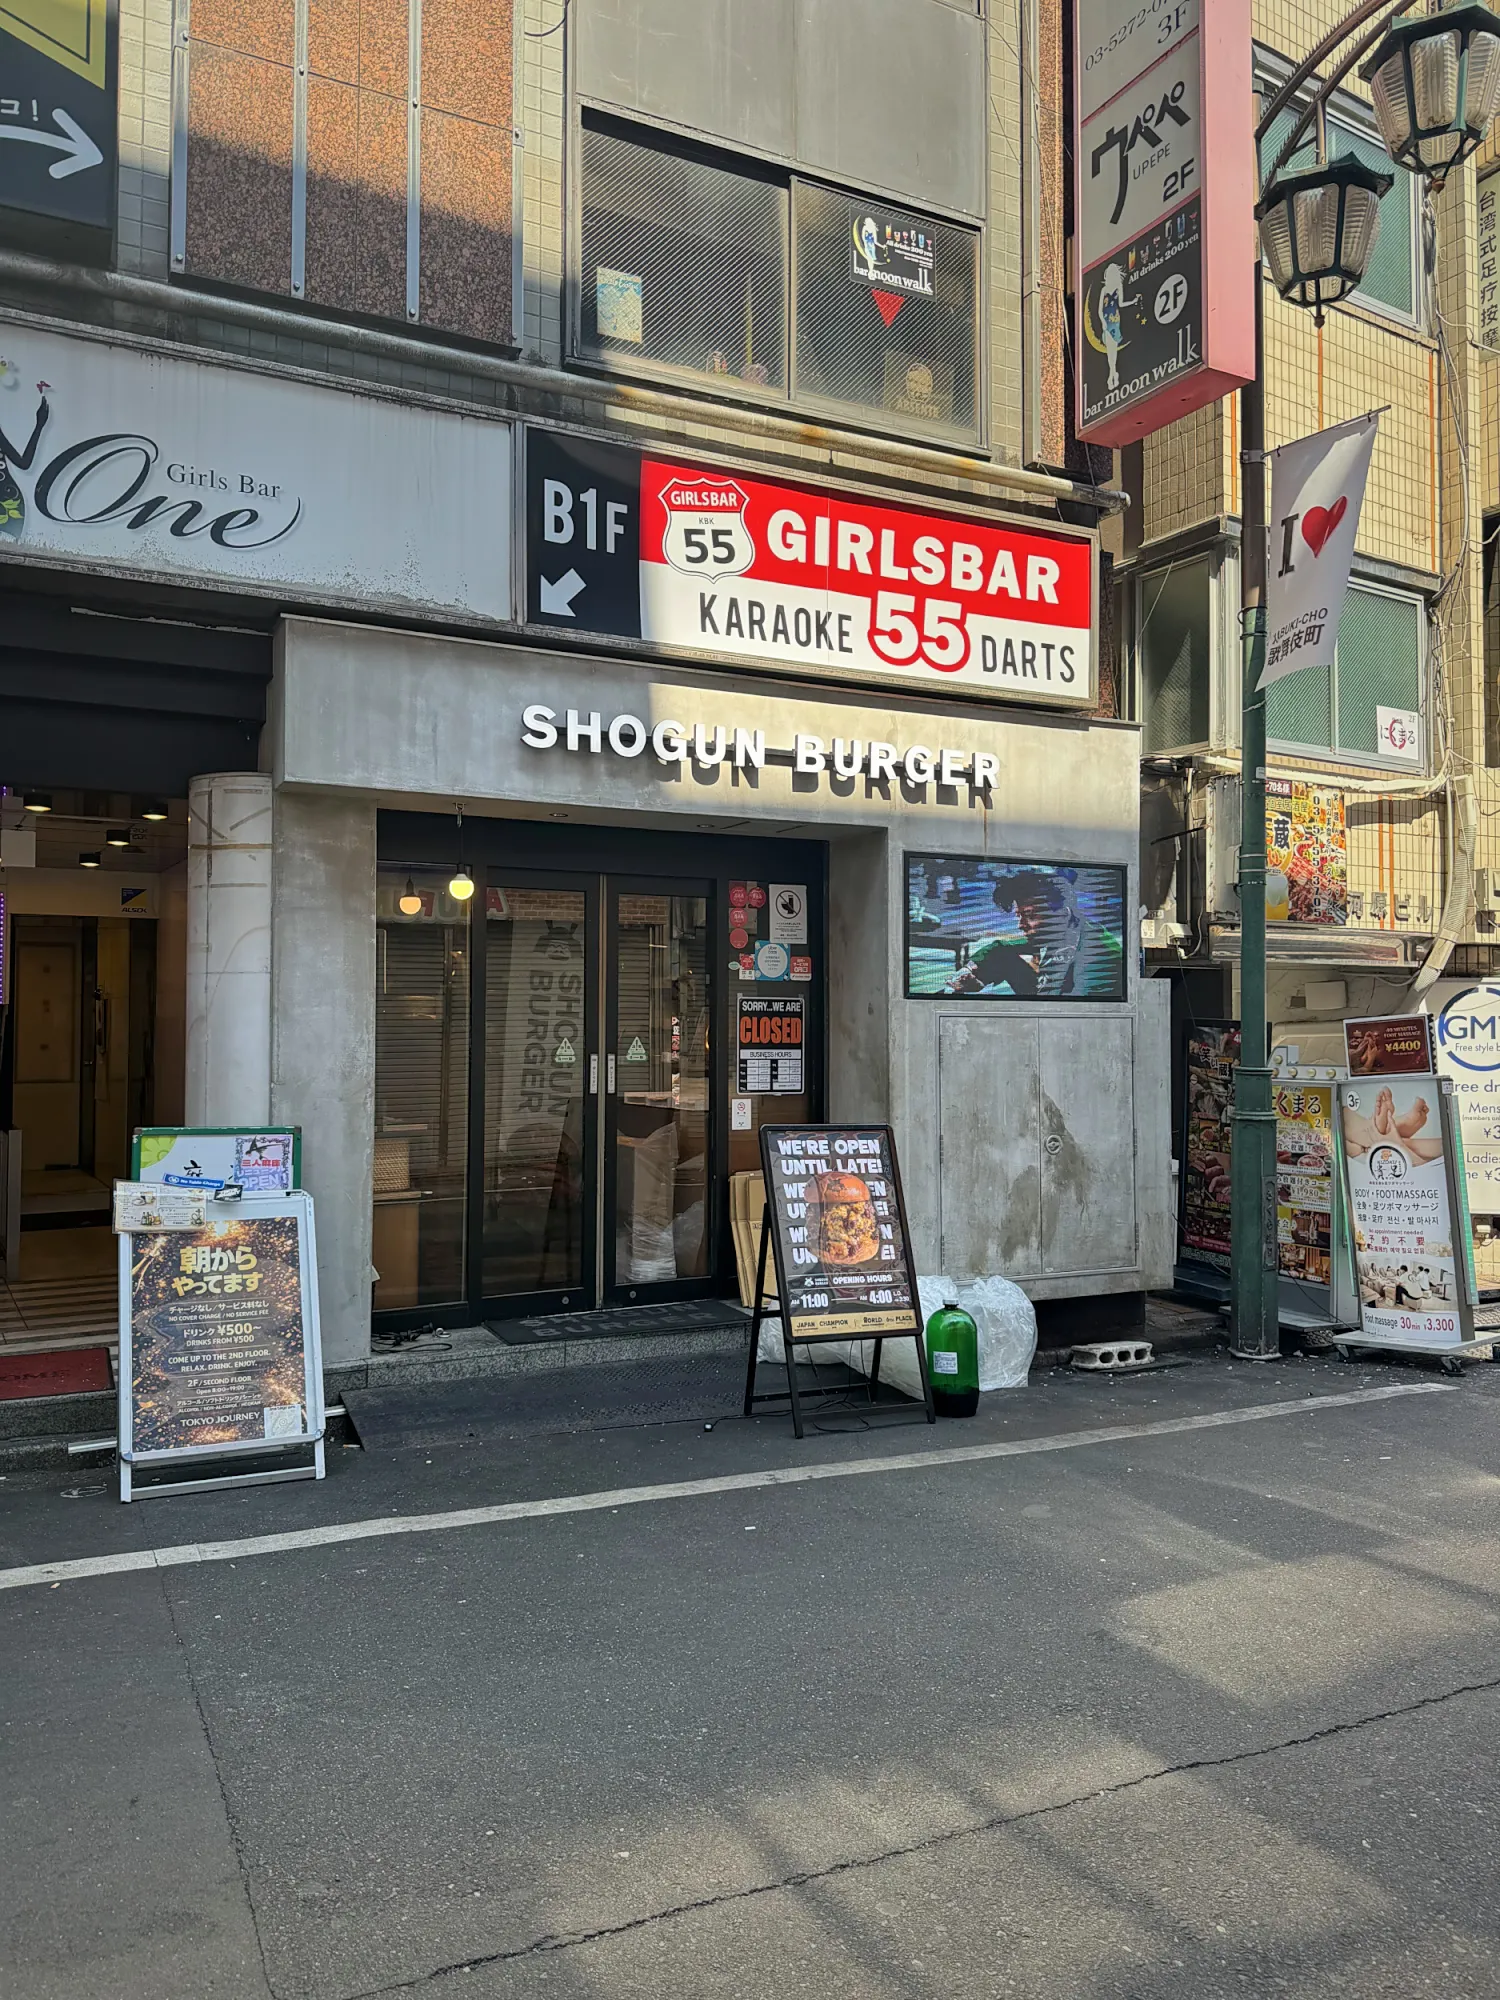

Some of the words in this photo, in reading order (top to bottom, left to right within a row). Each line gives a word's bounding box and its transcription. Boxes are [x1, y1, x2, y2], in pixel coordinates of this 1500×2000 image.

[1157, 0, 1191, 44] 3F
[1133, 143, 1171, 180] UPEPE
[1163, 158, 1195, 202] 2F
[1128, 268, 1140, 284] All
[1140, 256, 1164, 276] drinks
[1164, 242, 1184, 260] 200
[1184, 232, 1199, 250] yen
[1158, 279, 1184, 318] 2F
[1084, 383, 1104, 420] bar
[166, 463, 228, 490] Girls
[238, 474, 281, 498] Bar
[34, 433, 301, 549] One
[544, 478, 628, 554] B1F
[698, 517, 714, 526] KBK
[684, 528, 736, 564] 55
[766, 508, 1060, 605] GIRLSBAR
[700, 592, 853, 654] KARAOKE
[869, 590, 971, 672] 55
[981, 634, 1076, 684] DARTS
[1268, 624, 1326, 666] 歌舞伎町
[520, 704, 766, 768] SHOGUN
[796, 733, 1000, 789] BURGER
[786, 1002, 801, 1012] ARE
[740, 1016, 802, 1044] CLOSED
[518, 970, 553, 1114] BURGER
[1384, 1040, 1421, 1052] ¥4400
[1455, 1042, 1474, 1052] Free
[1475, 1042, 1494, 1054] style
[1348, 1094, 1360, 1108] 3F
[1314, 1118, 1331, 1130] 2F
[778, 1138, 830, 1156] WE'RE
[834, 1139, 880, 1156] OPEN
[780, 1159, 832, 1176] UNTIL
[836, 1158, 883, 1174] LATE!
[239, 1174, 280, 1189] OPEN
[1354, 1188, 1370, 1198] BODY
[1376, 1190, 1440, 1199] FOOTMASSAGE
[1368, 1234, 1424, 1246] 予約不要
[180, 1246, 258, 1274] 朝から
[172, 1272, 264, 1297] やってます
[832, 1276, 866, 1284] OPENING
[866, 1274, 892, 1283] HOURS
[800, 1293, 828, 1309] 11:00
[869, 1290, 892, 1304] 4:00
[532, 1312, 718, 1338] BURGER
[819, 1319, 848, 1327] CHAMPION
[1374, 1316, 1398, 1330] massage
[184, 1328, 216, 1338] ドリンク
[186, 1338, 212, 1347] DRINKS
[212, 1336, 232, 1345] FROM
[233, 1334, 254, 1344] ¥500
[168, 1356, 188, 1364] COME
[190, 1355, 200, 1363] UP
[212, 1353, 227, 1361] THE
[228, 1351, 244, 1360] 2ND
[181, 1365, 207, 1373] RELAX.
[208, 1362, 233, 1371] DRINK.
[203, 1378, 230, 1387] SECOND
[230, 1376, 252, 1384] FLOOR
[180, 1416, 214, 1427] TOKYO
[216, 1412, 260, 1424] JOURNEY
